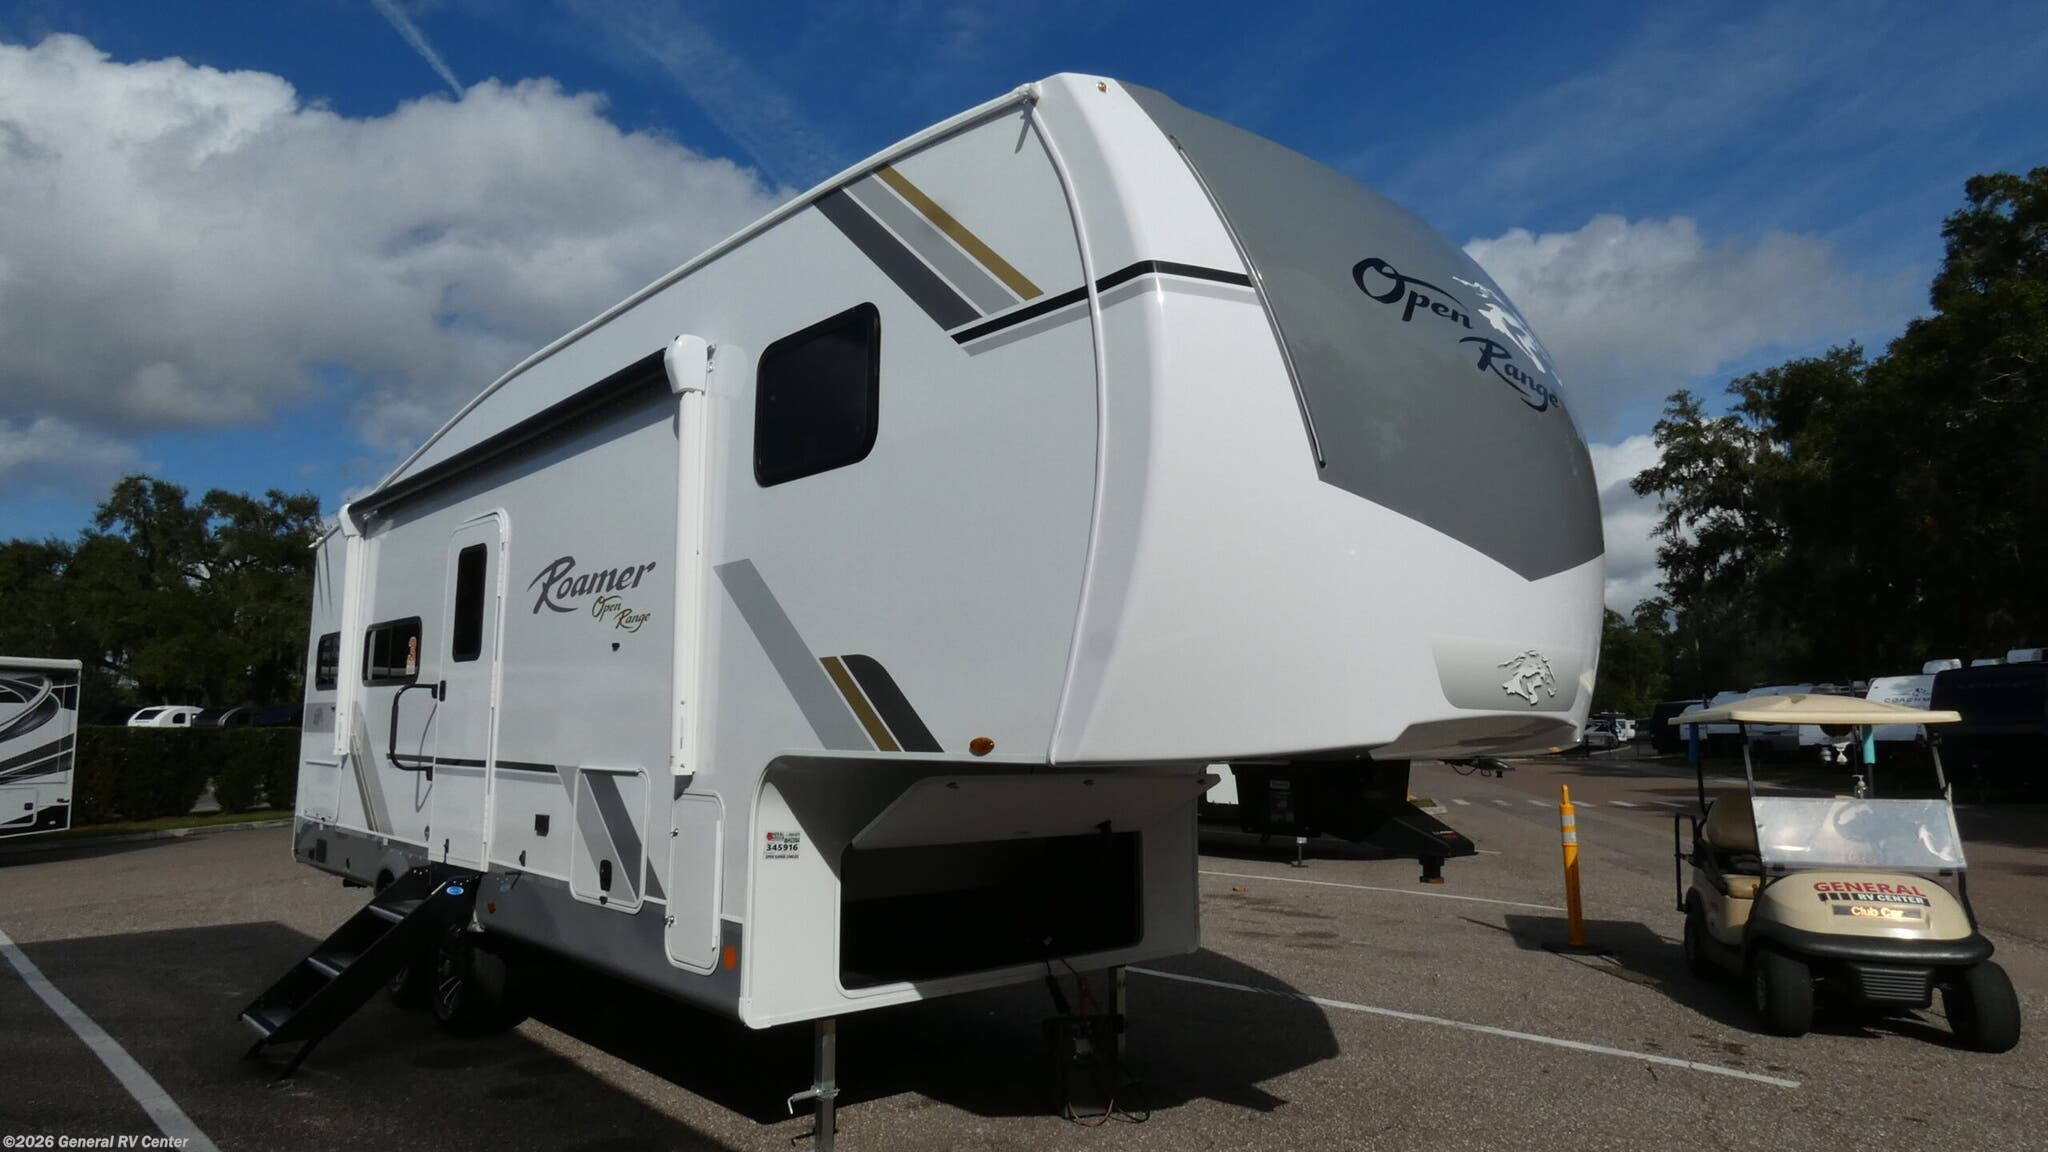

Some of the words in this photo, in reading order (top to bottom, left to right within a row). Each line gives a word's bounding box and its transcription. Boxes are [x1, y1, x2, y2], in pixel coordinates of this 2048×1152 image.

[1352, 257, 1473, 329] Open
[1459, 336, 1560, 412] Range
[527, 556, 656, 614] Roamer
[592, 595, 622, 622] Open
[613, 608, 651, 633] Range
[766, 843, 799, 852] 345916
[1813, 881, 1927, 897] GENERAL
[1857, 893, 1874, 901] RV
[1876, 894, 1925, 904] CENTER
[1851, 905, 1879, 917] Club
[1880, 907, 1905, 919] Car
